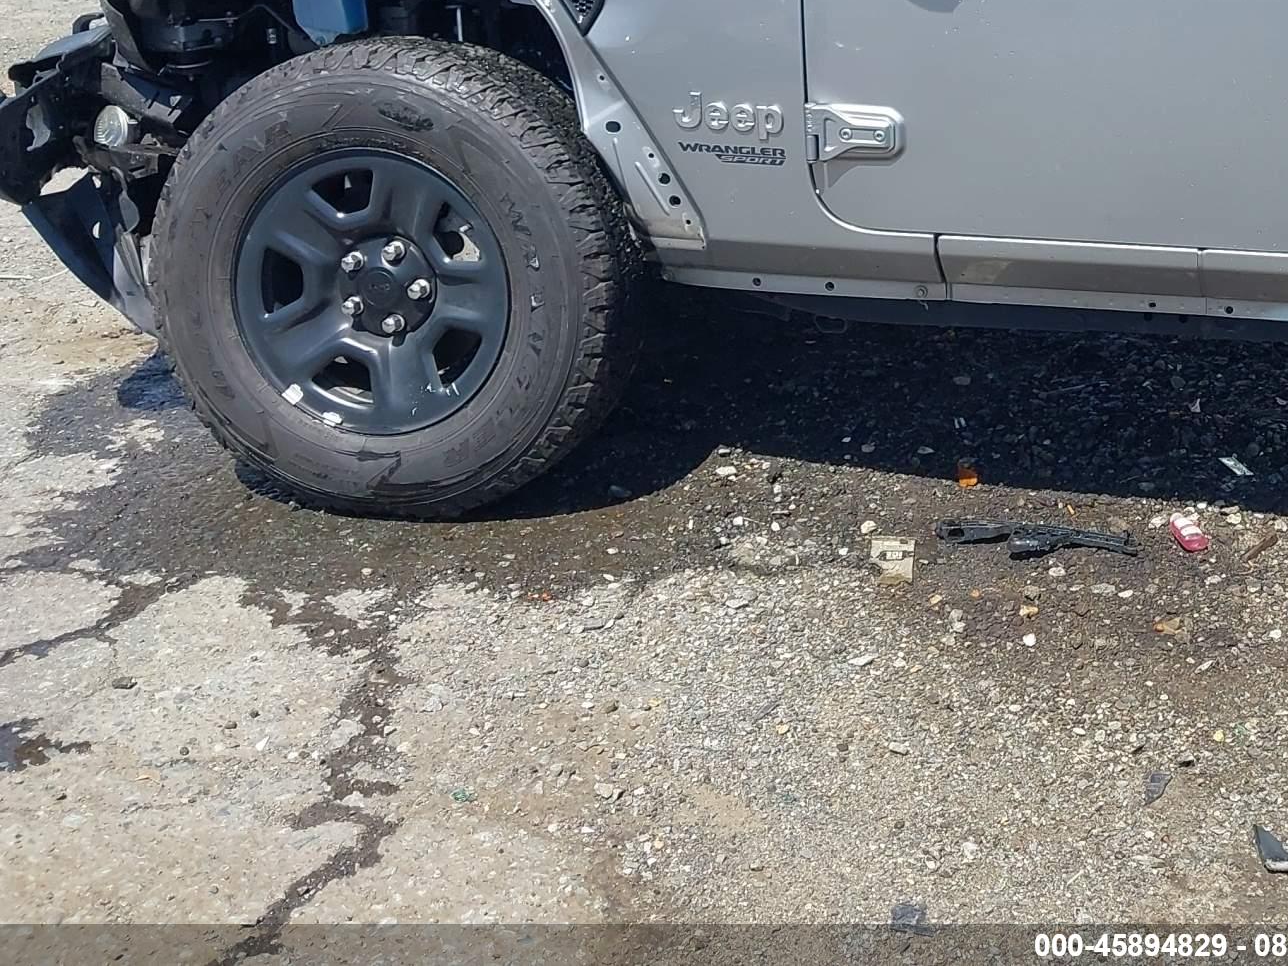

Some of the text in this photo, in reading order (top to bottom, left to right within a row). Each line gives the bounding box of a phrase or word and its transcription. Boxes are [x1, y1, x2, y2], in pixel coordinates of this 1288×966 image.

[672, 90, 785, 142] Jeep
[678, 141, 786, 157] WRANGLER
[717, 154, 786, 166] SPORT
